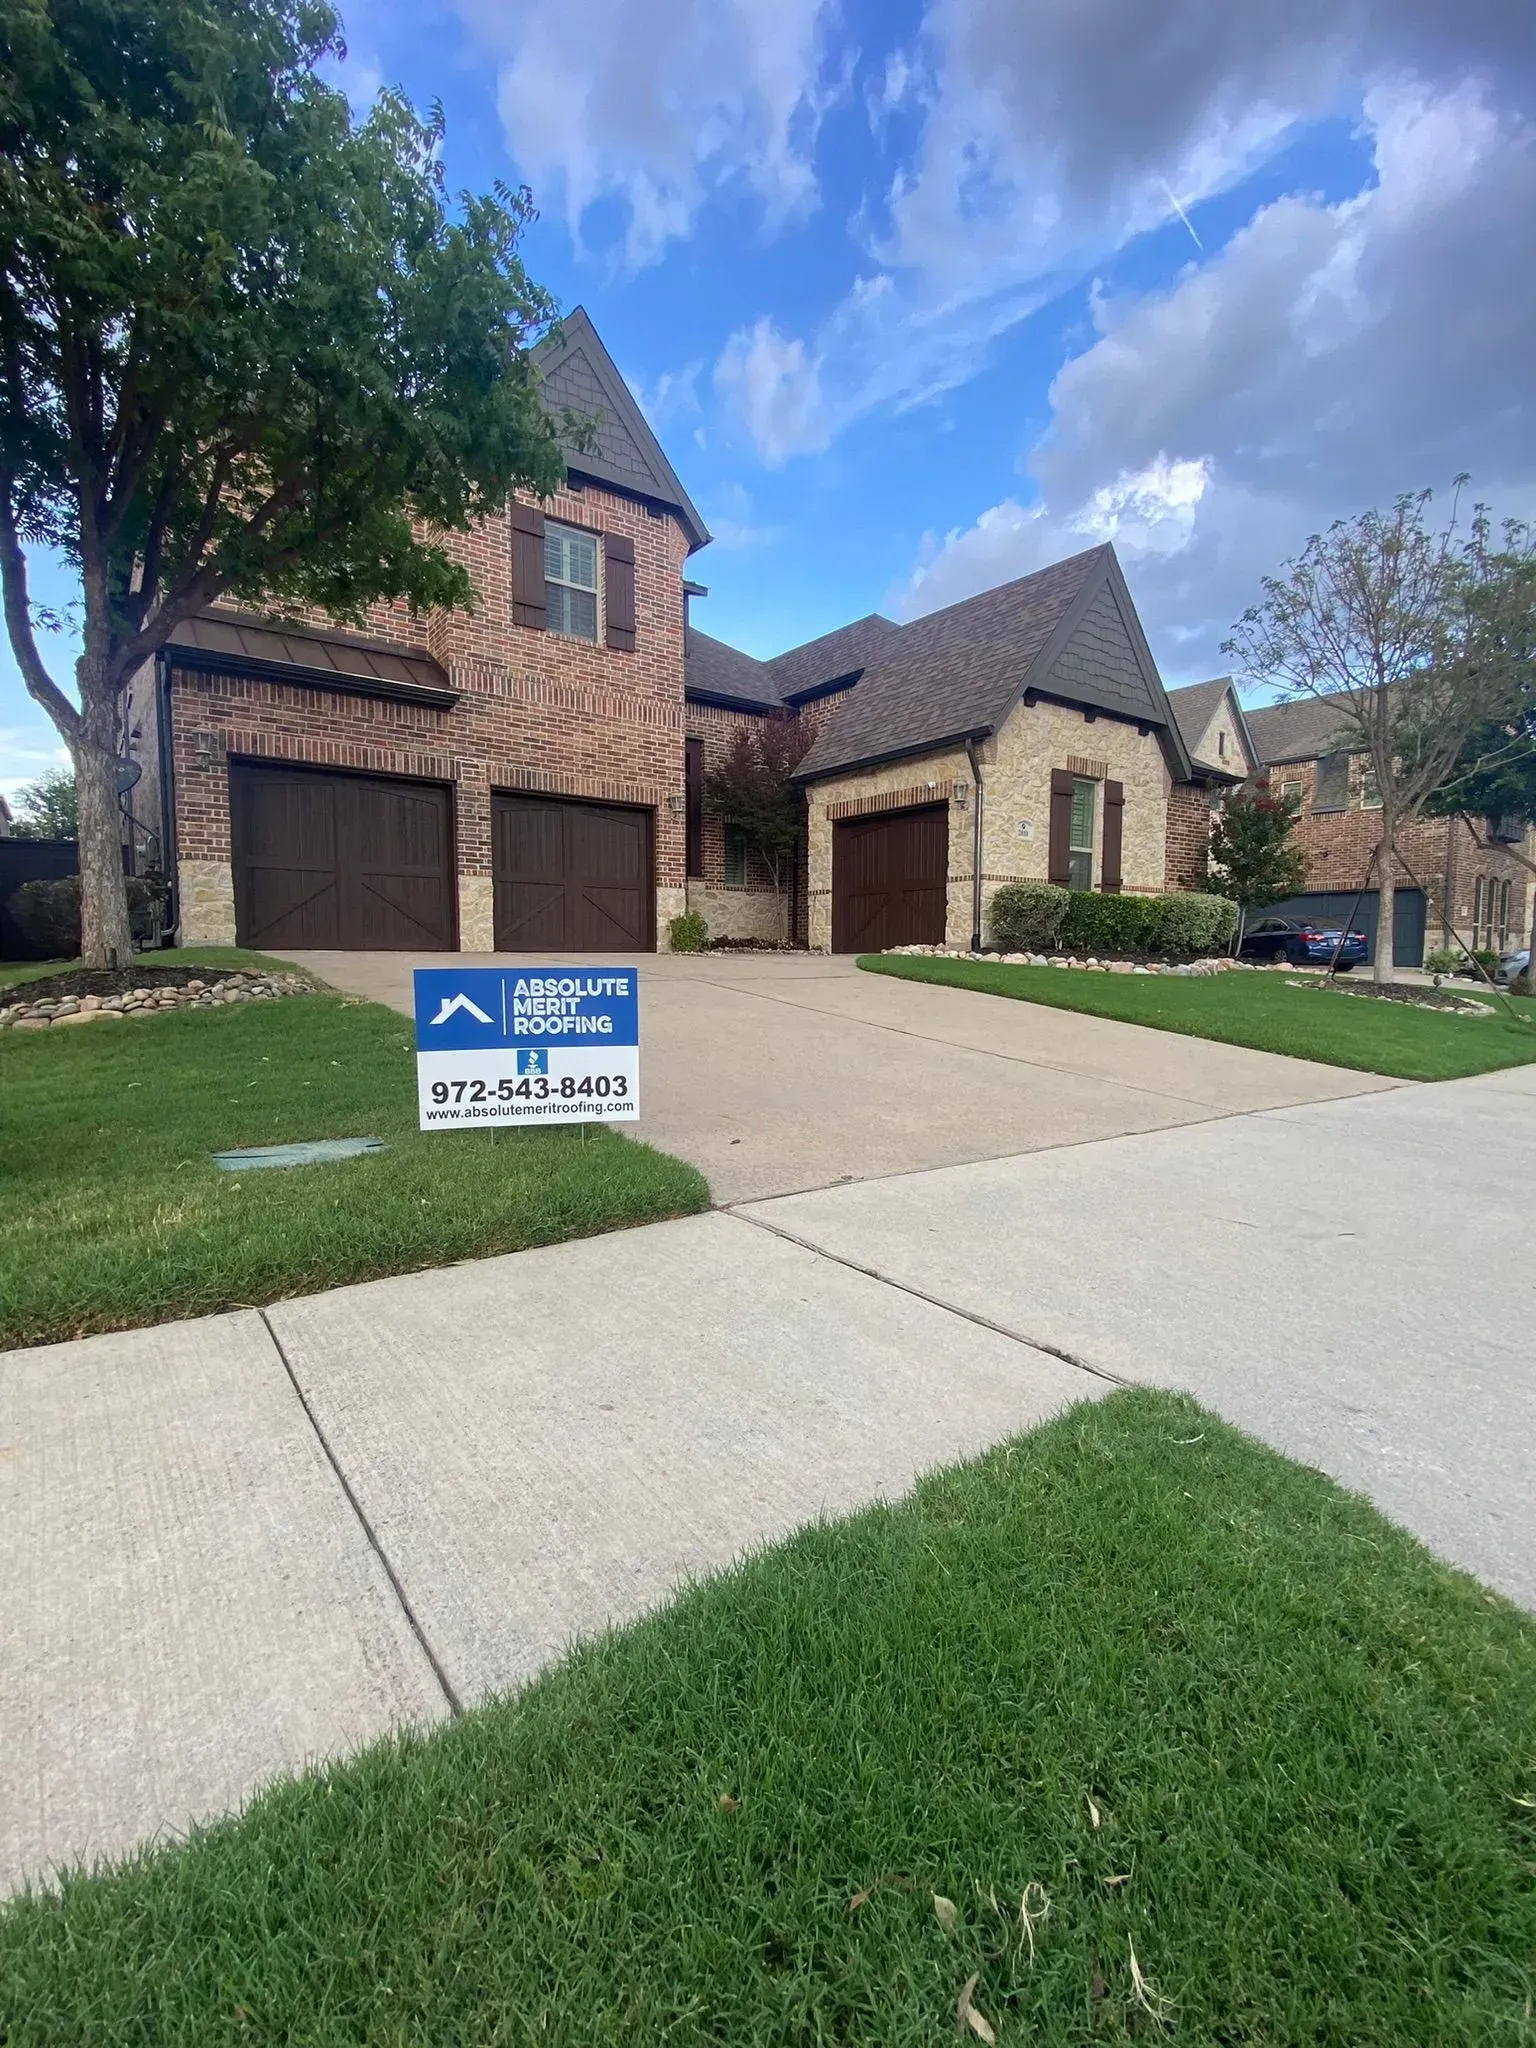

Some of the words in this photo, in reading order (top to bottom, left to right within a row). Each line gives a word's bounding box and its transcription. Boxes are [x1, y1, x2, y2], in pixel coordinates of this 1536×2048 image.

[513, 978, 629, 996] ABSOLUTE
[514, 997, 581, 1016] MERIT
[514, 1015, 613, 1035] ROOFING
[431, 1075, 628, 1104] 972-543-8403
[426, 1102, 634, 1120] www.absolutemeritroofing.com
